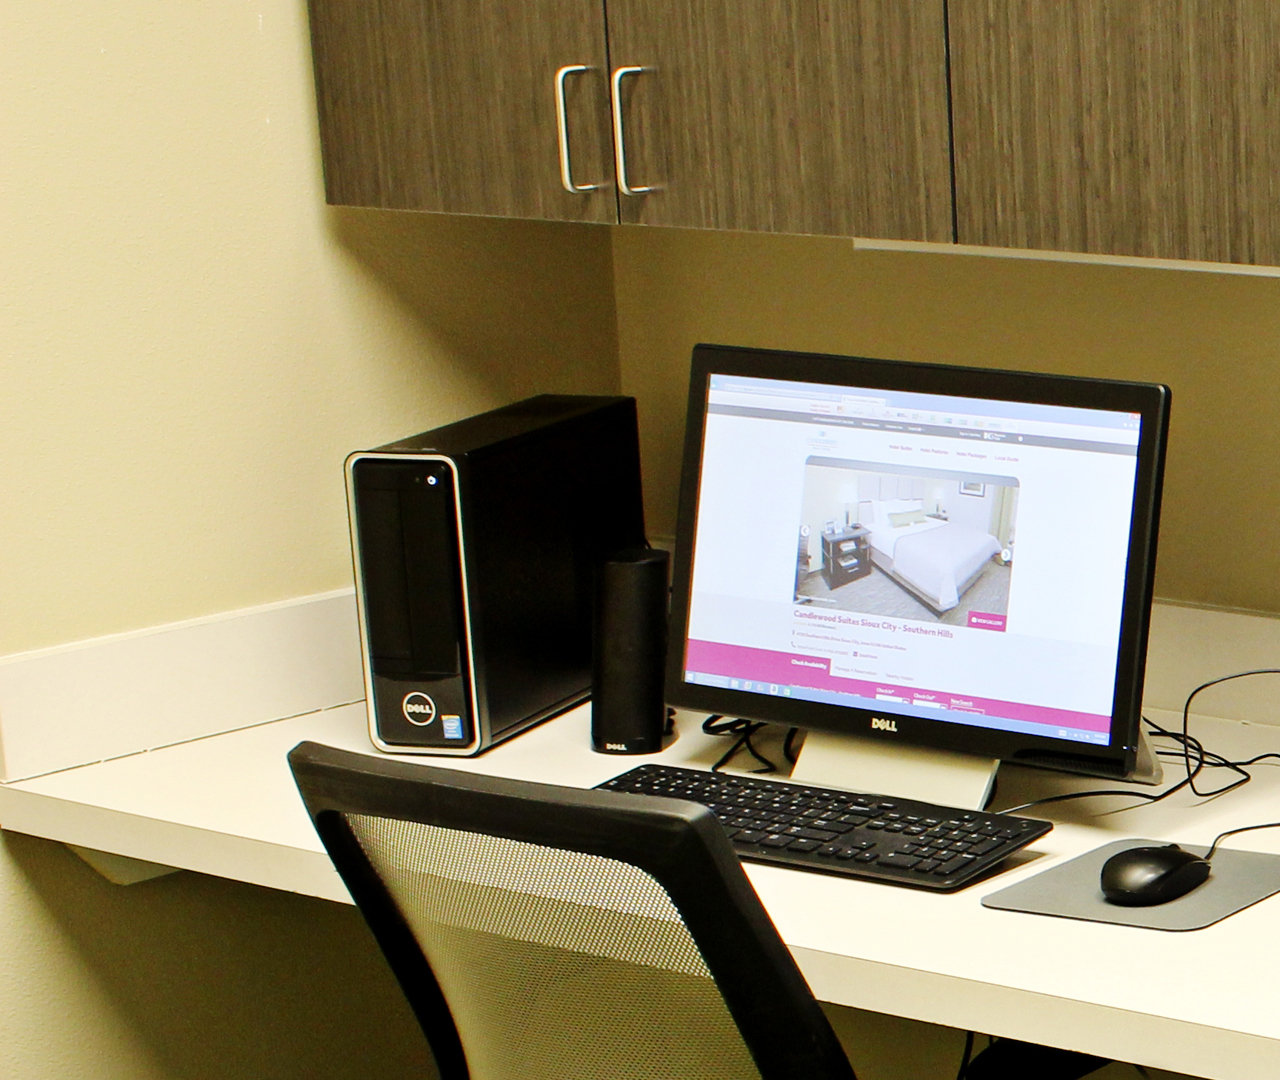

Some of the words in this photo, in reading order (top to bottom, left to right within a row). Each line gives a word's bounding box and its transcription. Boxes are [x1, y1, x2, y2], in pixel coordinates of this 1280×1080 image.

[793, 609, 837, 623] Candlewood
[881, 621, 897, 632] City
[406, 703, 432, 714] DELL
[871, 717, 898, 732] DELL
